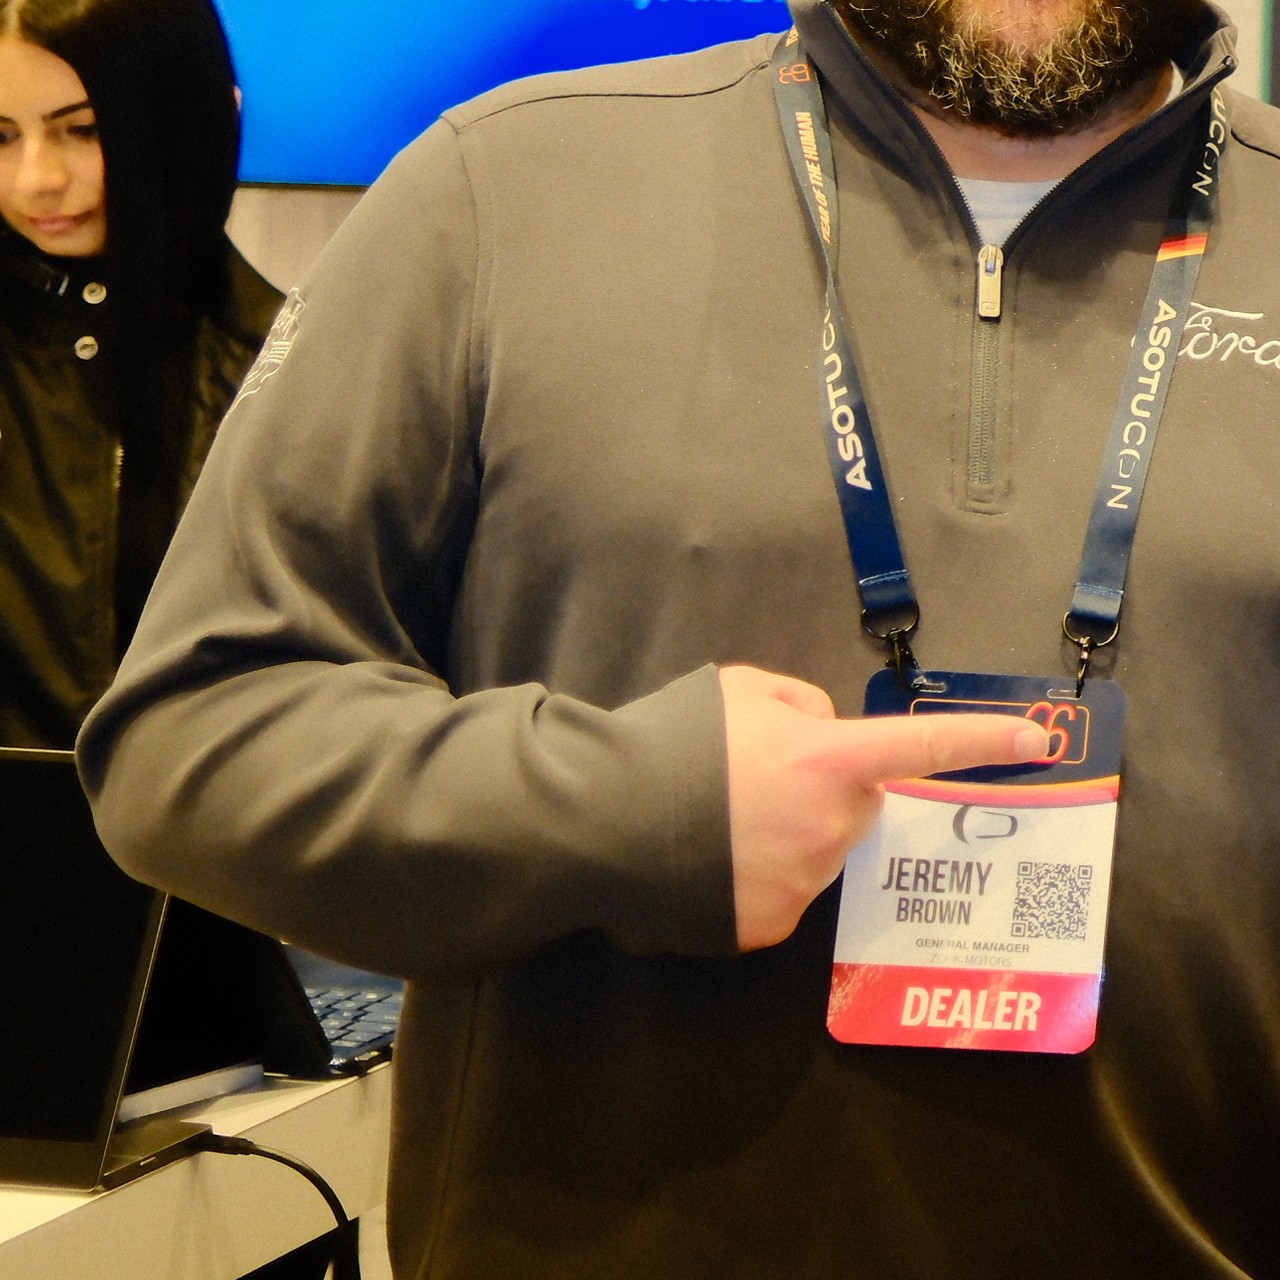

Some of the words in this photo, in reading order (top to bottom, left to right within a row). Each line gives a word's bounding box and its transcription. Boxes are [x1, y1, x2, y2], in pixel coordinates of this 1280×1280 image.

[796, 111, 819, 162] HUMAN
[806, 159, 824, 188] THE
[813, 186, 828, 208] OF
[819, 205, 831, 244] YEAR
[881, 856, 994, 897] JEREMY
[896, 896, 973, 926] BROWN
[972, 941, 1031, 954] MANAGER
[900, 985, 1043, 1033] DEALER
